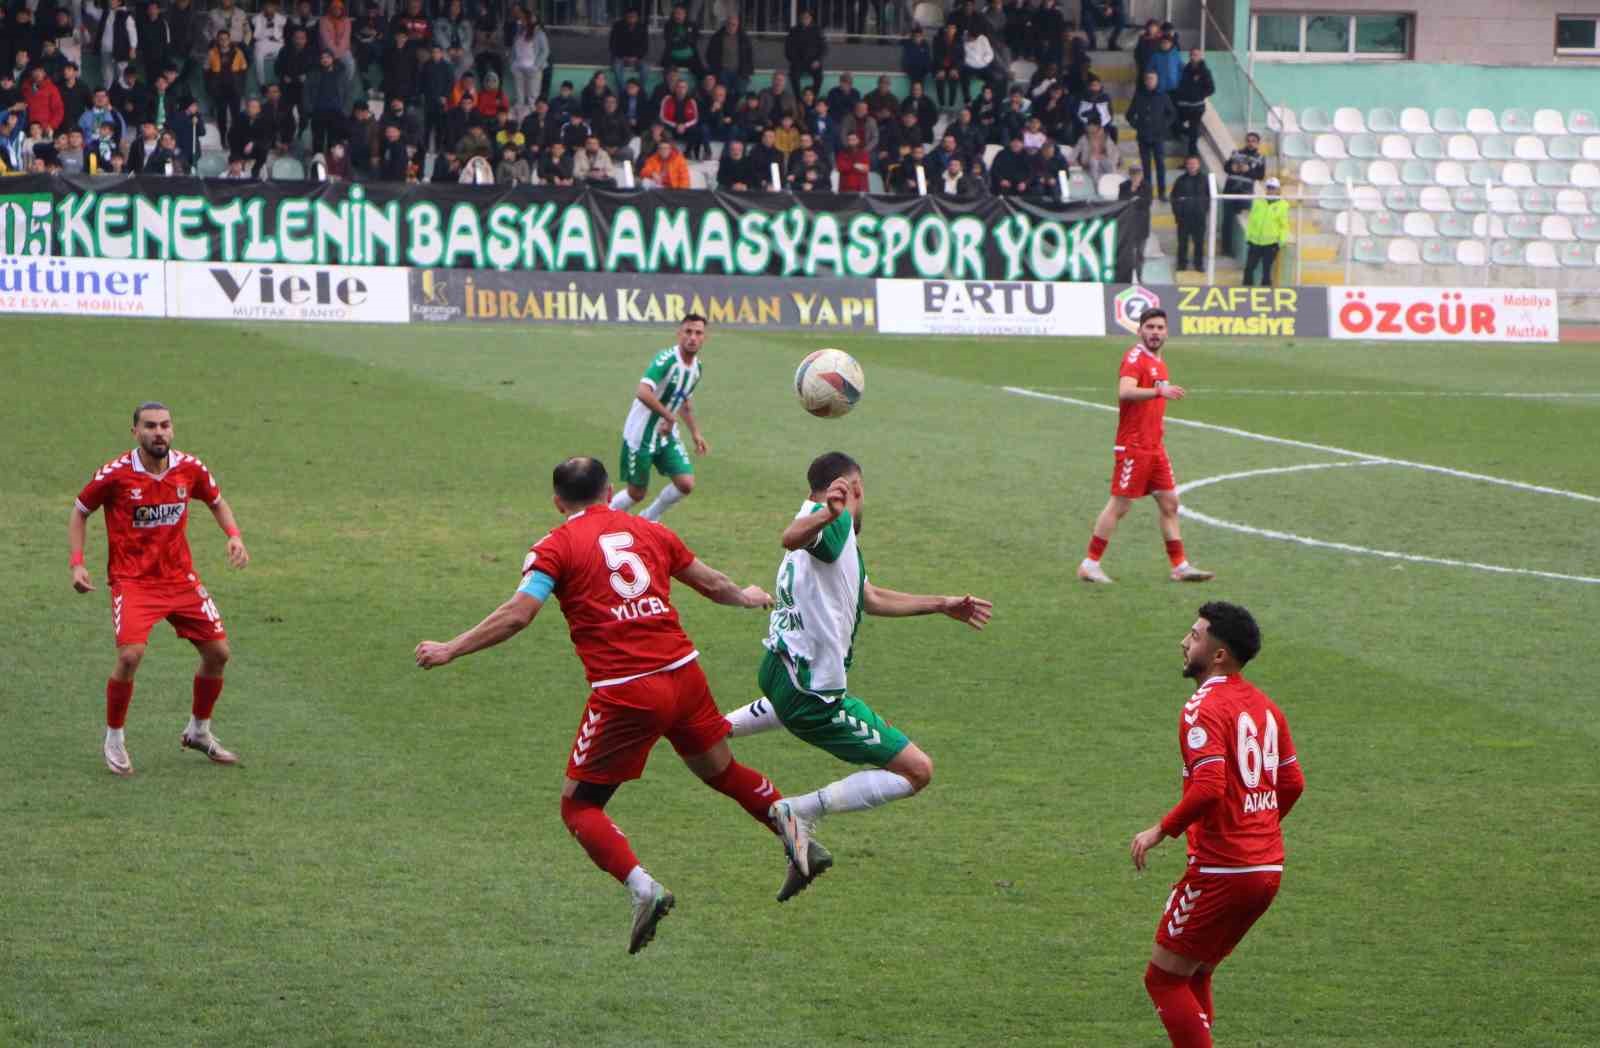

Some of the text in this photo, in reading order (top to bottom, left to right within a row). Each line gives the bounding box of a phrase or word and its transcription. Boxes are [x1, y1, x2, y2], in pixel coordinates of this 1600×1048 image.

[58, 184, 399, 265] KENETLENİN
[604, 205, 986, 280] AMASYASPOR
[993, 213, 1118, 282] YOK!
[209, 267, 367, 306] Viele
[923, 281, 1055, 316] BARTU
[1177, 286, 1298, 312] ZAFER
[616, 287, 781, 324] KARAMAN
[791, 291, 876, 326] YAPI
[1339, 291, 1496, 335] ÖZGÜR
[598, 531, 650, 599] 5
[610, 597, 670, 621] YÜCEL
[1236, 709, 1280, 789] 64
